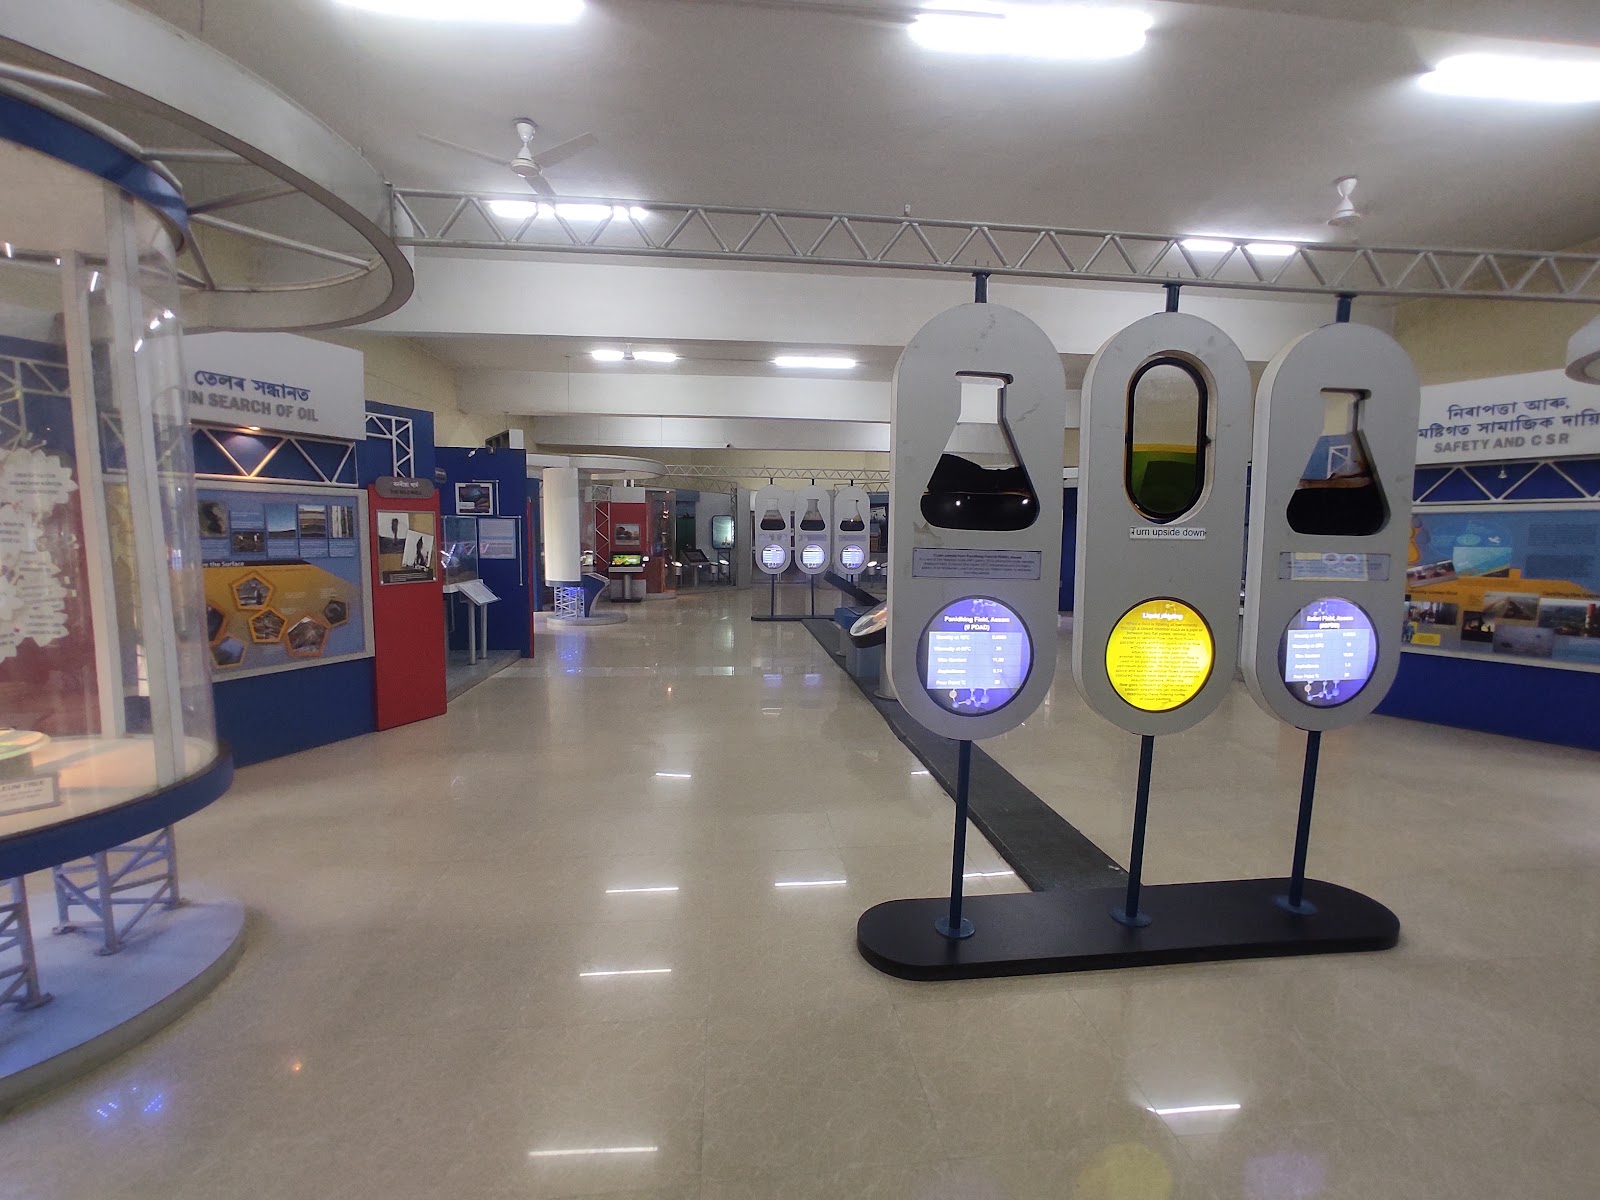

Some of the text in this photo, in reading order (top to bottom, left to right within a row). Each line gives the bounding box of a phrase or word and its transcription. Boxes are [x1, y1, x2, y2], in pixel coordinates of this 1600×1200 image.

[208, 393, 271, 415] SEARCH
[276, 404, 294, 418] OF
[297, 406, 319, 422] OIL
[1477, 415, 1554, 434] সামাজিক
[1434, 438, 1490, 453] SAFETY
[1493, 436, 1525, 449] AND
[1130, 526, 1205, 537] Turn upside down
